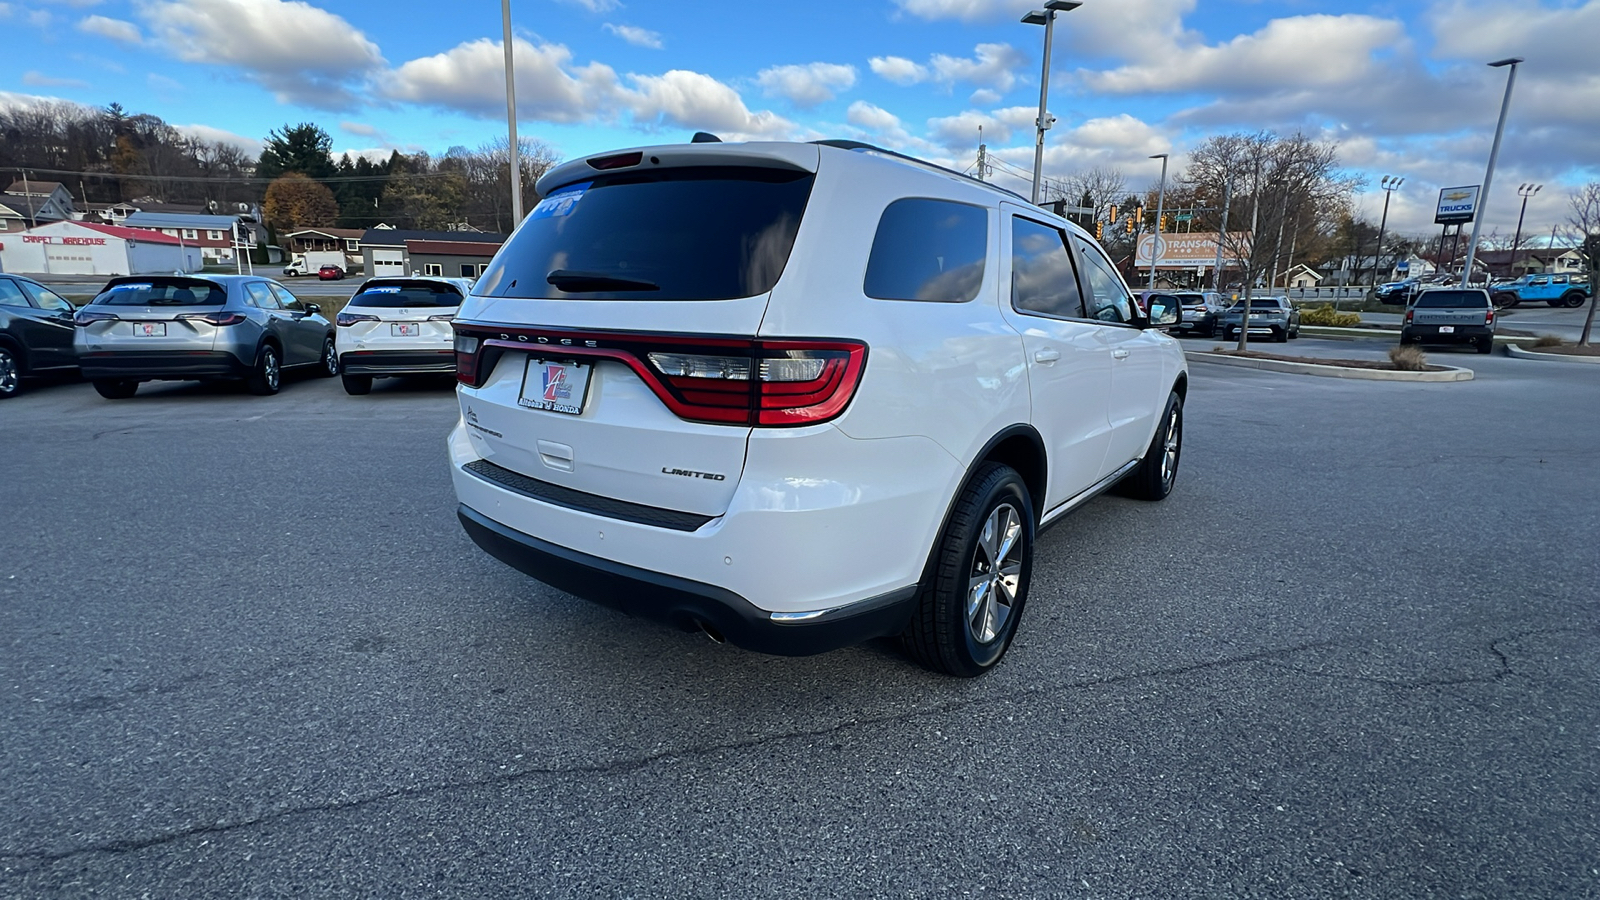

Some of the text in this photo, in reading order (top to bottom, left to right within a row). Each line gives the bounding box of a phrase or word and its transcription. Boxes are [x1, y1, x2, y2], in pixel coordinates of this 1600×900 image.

[1440, 204, 1472, 212] TRUCKS
[23, 236, 107, 246] CARPET WAREHOUSE
[500, 333, 597, 347] DODGE
[553, 403, 580, 415] HONDA
[661, 467, 725, 481] LIMITED
